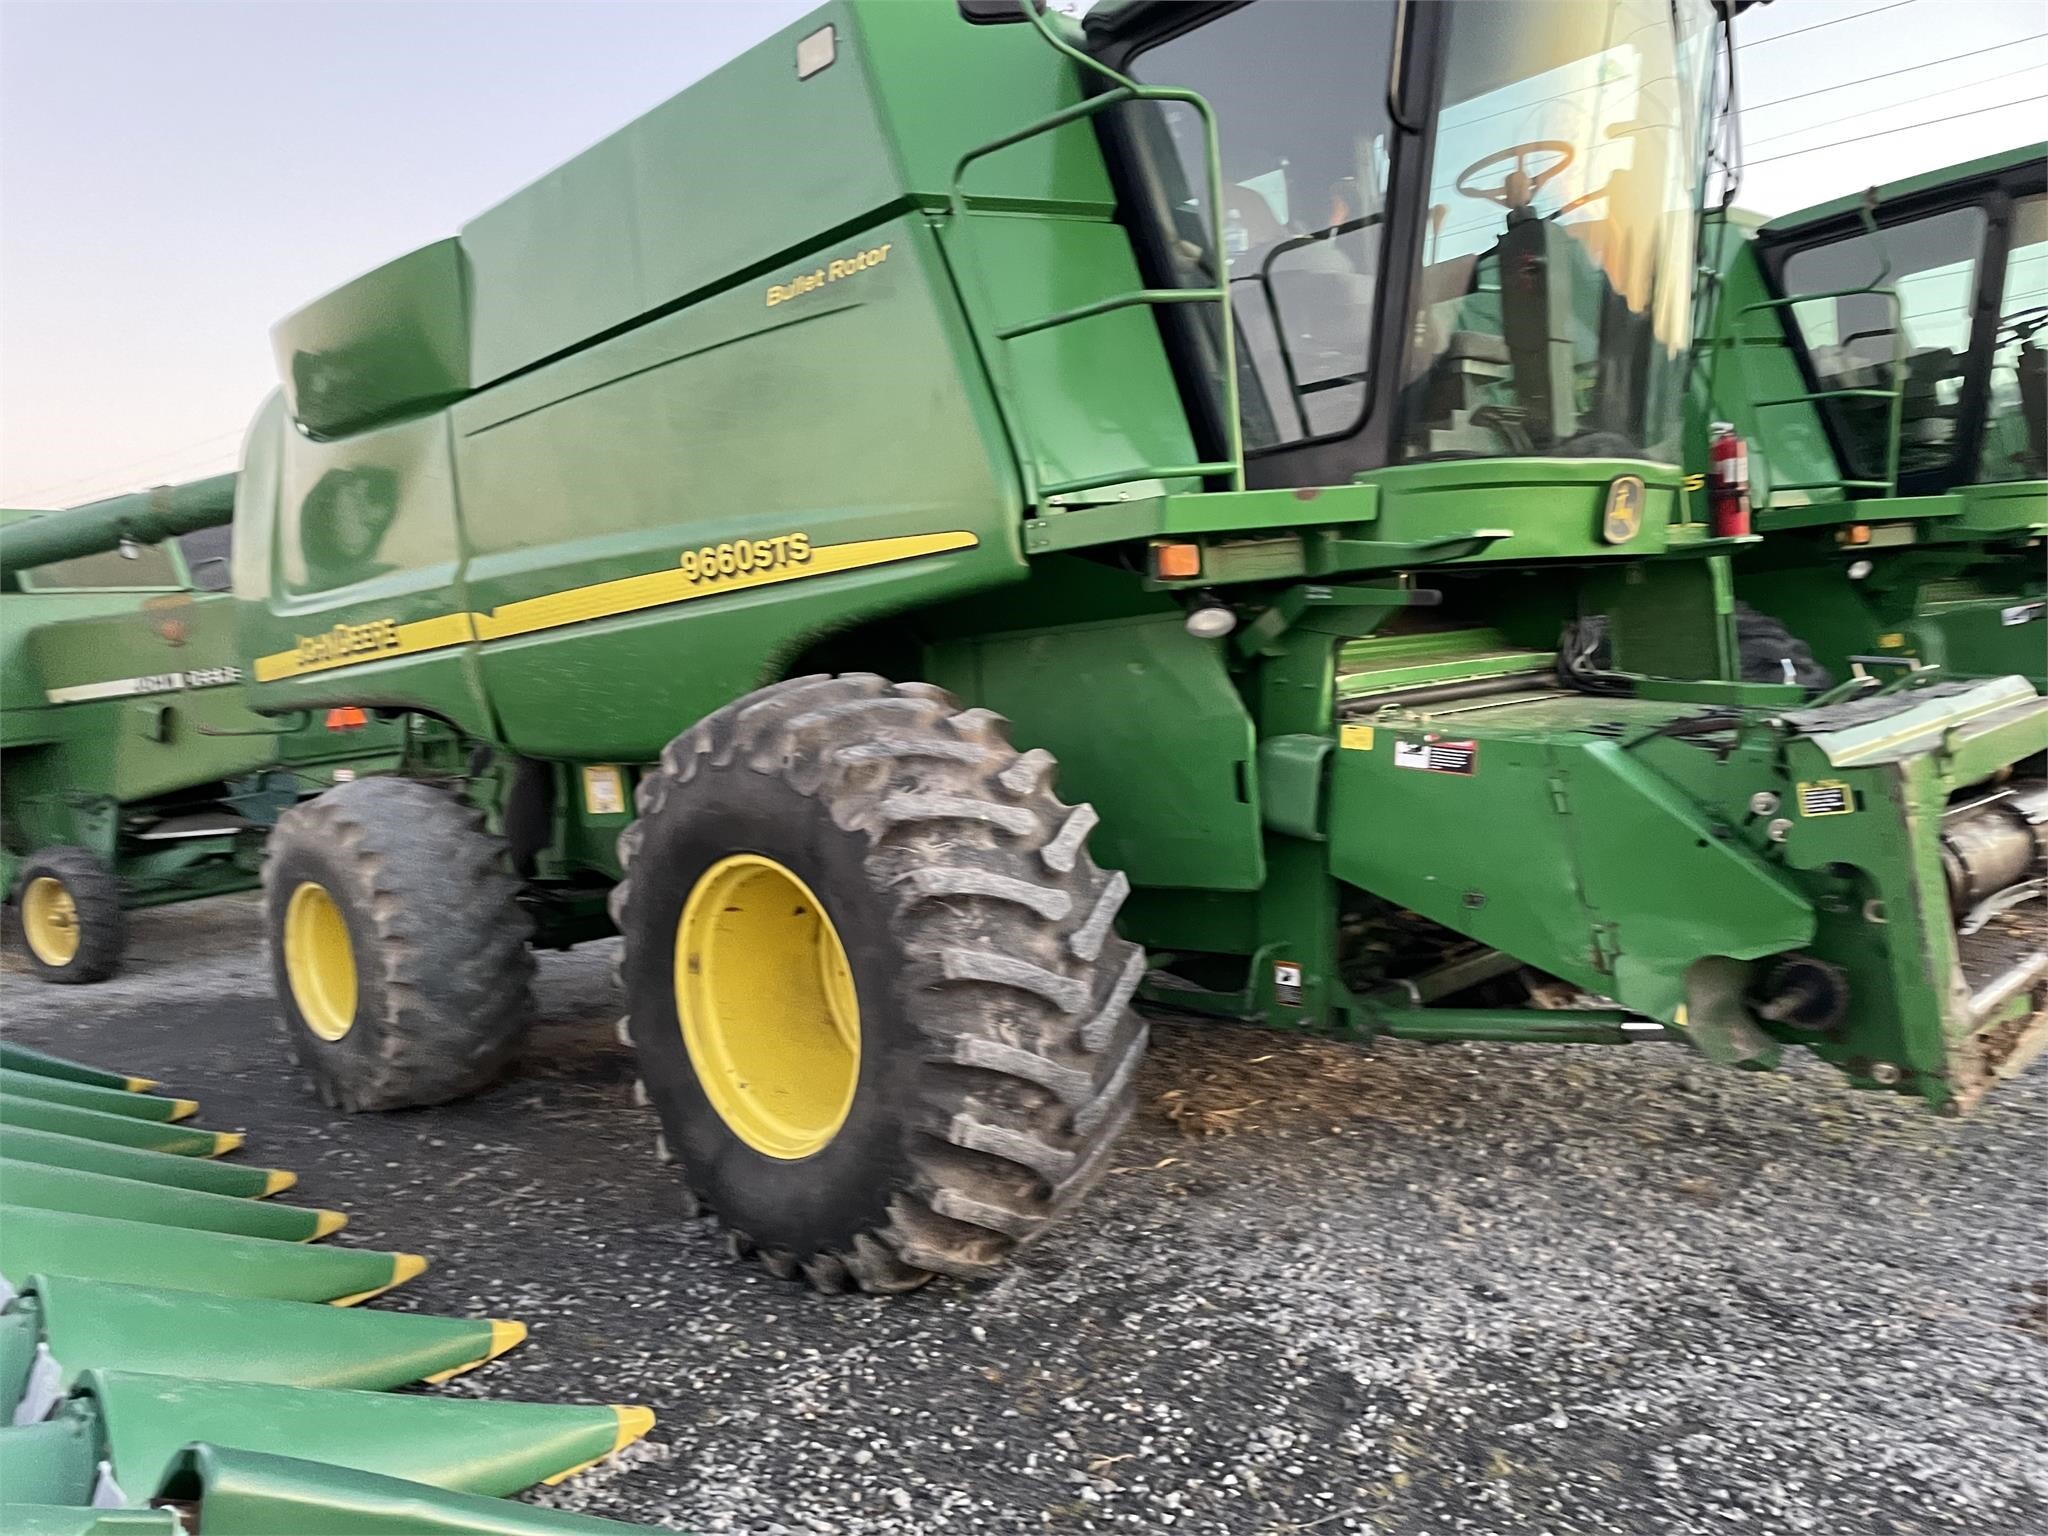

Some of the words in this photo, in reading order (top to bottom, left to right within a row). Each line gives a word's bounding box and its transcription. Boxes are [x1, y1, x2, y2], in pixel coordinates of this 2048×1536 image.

[766, 269, 825, 307] Bullet
[828, 244, 892, 281] Rotor
[680, 532, 811, 580] 9660STS
[334, 618, 398, 655] DEERE
